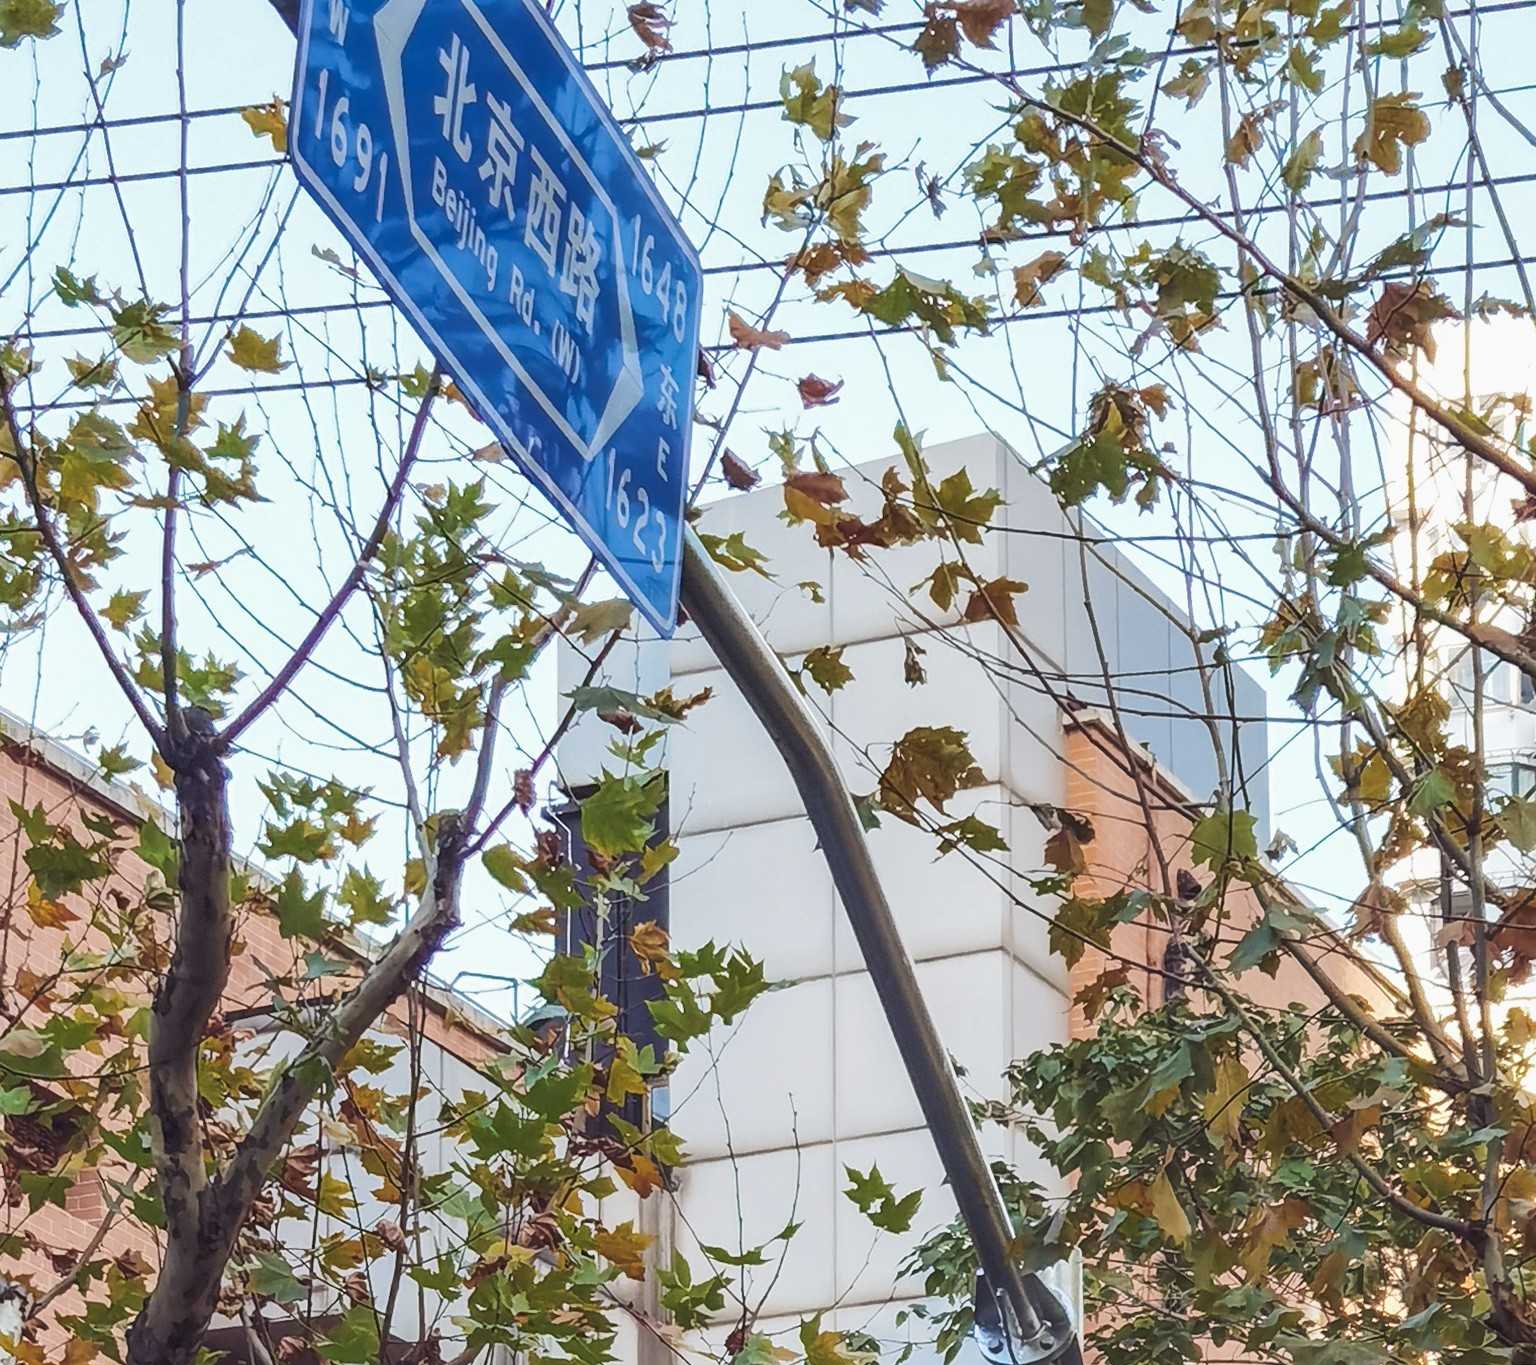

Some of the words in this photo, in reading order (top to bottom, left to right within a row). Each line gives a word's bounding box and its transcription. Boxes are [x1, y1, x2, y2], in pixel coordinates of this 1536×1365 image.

[315, 68, 388, 224] 1691
[433, 32, 601, 337] 北京西路
[431, 155, 498, 292] Beijing
[509, 263, 541, 336] Rd.
[551, 319, 581, 385] (W)
[631, 213, 687, 344] 1648
[656, 363, 680, 430] 东
[656, 436, 670, 482] E
[606, 448, 666, 574] 1623
